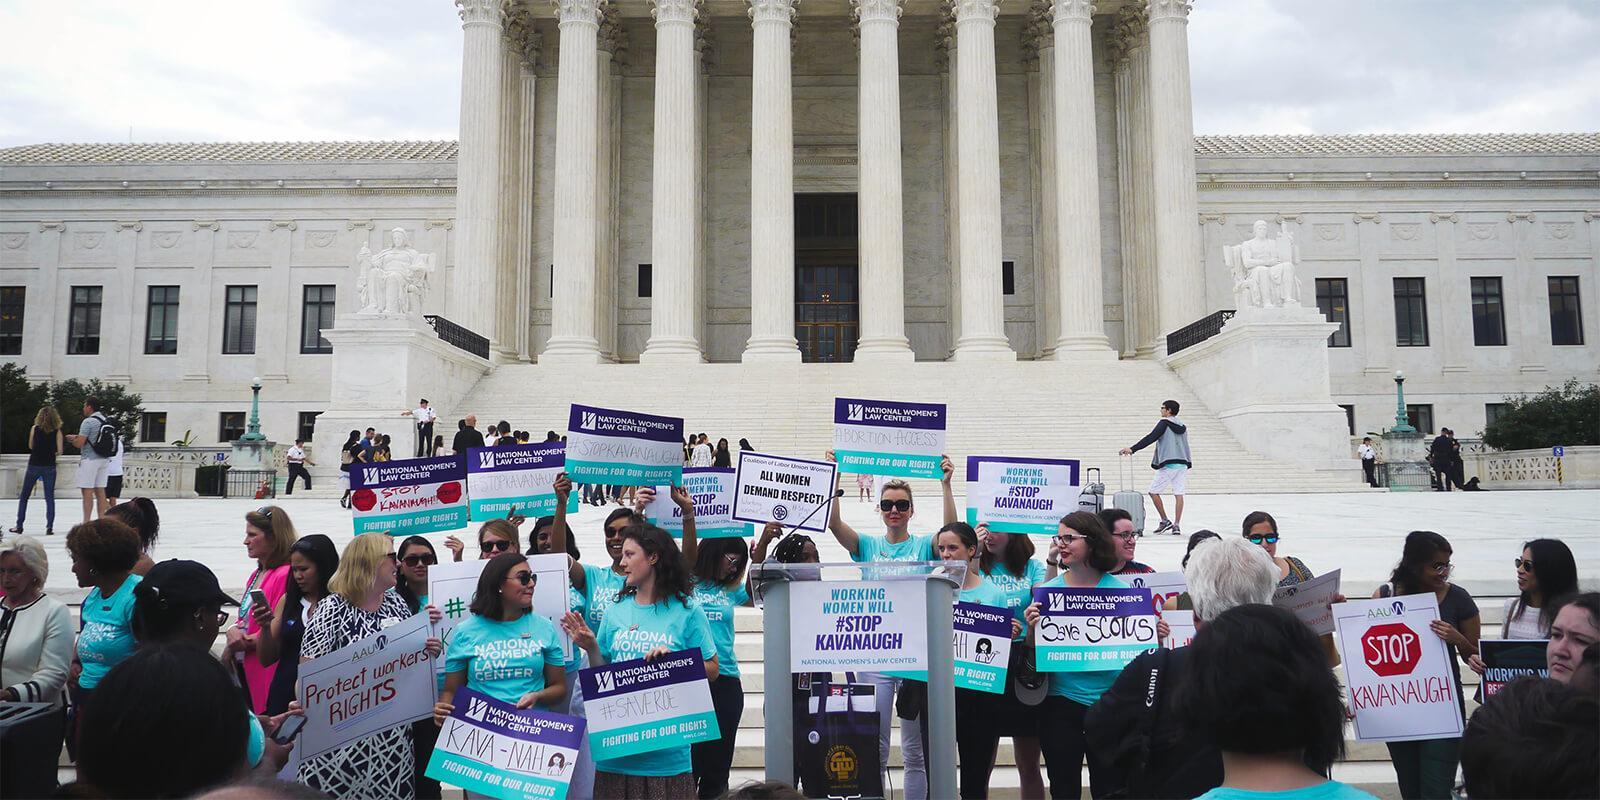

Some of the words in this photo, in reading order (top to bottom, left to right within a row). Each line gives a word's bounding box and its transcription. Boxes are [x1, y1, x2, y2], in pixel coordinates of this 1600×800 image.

[865, 406, 902, 415] NATIONAL
[903, 409, 938, 417] WOMEN'S
[598, 416, 636, 426] NATIONAL
[638, 420, 674, 430] WOMEN'S
[617, 425, 647, 433] CENTER
[835, 428, 892, 444] ABORTION
[895, 430, 938, 446] ACCESS
[496, 450, 532, 459] NATIONAL
[380, 465, 419, 475] NATIONAL
[421, 462, 456, 471] WOMEN'S
[842, 456, 874, 464] FIGHTING
[876, 457, 890, 466] FOR
[892, 459, 907, 467] OUR
[909, 461, 935, 469] RIGHTS
[400, 472, 430, 480] CENTER
[574, 466, 609, 475] FIGHTING
[627, 469, 642, 477] OUR
[760, 470, 775, 481] ALL
[776, 472, 811, 486] WOMEN
[1006, 468, 1043, 476] WORKING
[1000, 476, 1028, 485] WOMEN
[1030, 478, 1048, 486] WILL
[381, 485, 421, 498] STOP
[744, 485, 779, 499] DEMAND
[781, 489, 824, 505] RESPECT!
[1008, 486, 1040, 497] #STOP
[480, 503, 510, 512] FIGHTING
[528, 500, 542, 508] OUR
[690, 494, 716, 505] STOP
[994, 497, 1053, 510] KAVANAUGH
[364, 520, 396, 530] FIGHTING
[398, 519, 412, 527] FOR
[415, 516, 430, 525] OUR
[432, 512, 458, 522] RIGHTS
[832, 588, 885, 600] WORKING
[823, 602, 865, 614] WOMEN
[868, 601, 894, 613] WILL
[1368, 601, 1406, 618] AAUW
[953, 616, 975, 626] NTER
[966, 610, 1004, 623] WOMEN'S
[836, 616, 882, 632] #STOP
[1041, 616, 1080, 641] Save
[1085, 616, 1153, 643] SCOTUS
[352, 635, 388, 662] AAUW
[474, 639, 544, 656] NATIONAL
[816, 633, 903, 650] KAVANAUGH
[1048, 652, 1082, 661] FIGHTING
[1084, 652, 1099, 660] FOR
[1102, 651, 1118, 660] OUR
[1367, 633, 1414, 665] STOP
[474, 660, 507, 672] LAW
[615, 665, 657, 678] NATIONAL
[658, 658, 694, 670] WOMEN'S
[306, 667, 367, 708] Protect
[374, 649, 428, 679] workers
[475, 668, 533, 681] CENTER
[616, 678, 636, 687] LAW
[638, 671, 670, 682] CENTER
[954, 667, 965, 676] UR
[967, 669, 996, 681] RIGHTS
[1146, 668, 1158, 707] Canon
[1351, 676, 1452, 710] KAVANAUGH
[330, 679, 396, 725] RIGHTS
[600, 687, 679, 720] #SAVEROE
[486, 714, 506, 727] LAW
[508, 722, 541, 735] CENTER
[488, 706, 531, 725] NATIONAL
[533, 718, 574, 732] WOMEN'S
[603, 733, 639, 747] FIGHTING
[641, 729, 657, 740] FOR
[660, 724, 677, 736] OUR
[680, 720, 707, 732] RIGHTS
[442, 760, 481, 779] FIGHTING
[483, 772, 500, 786] FOR
[503, 777, 521, 790] OUR
[523, 782, 556, 796] RIGHTS
